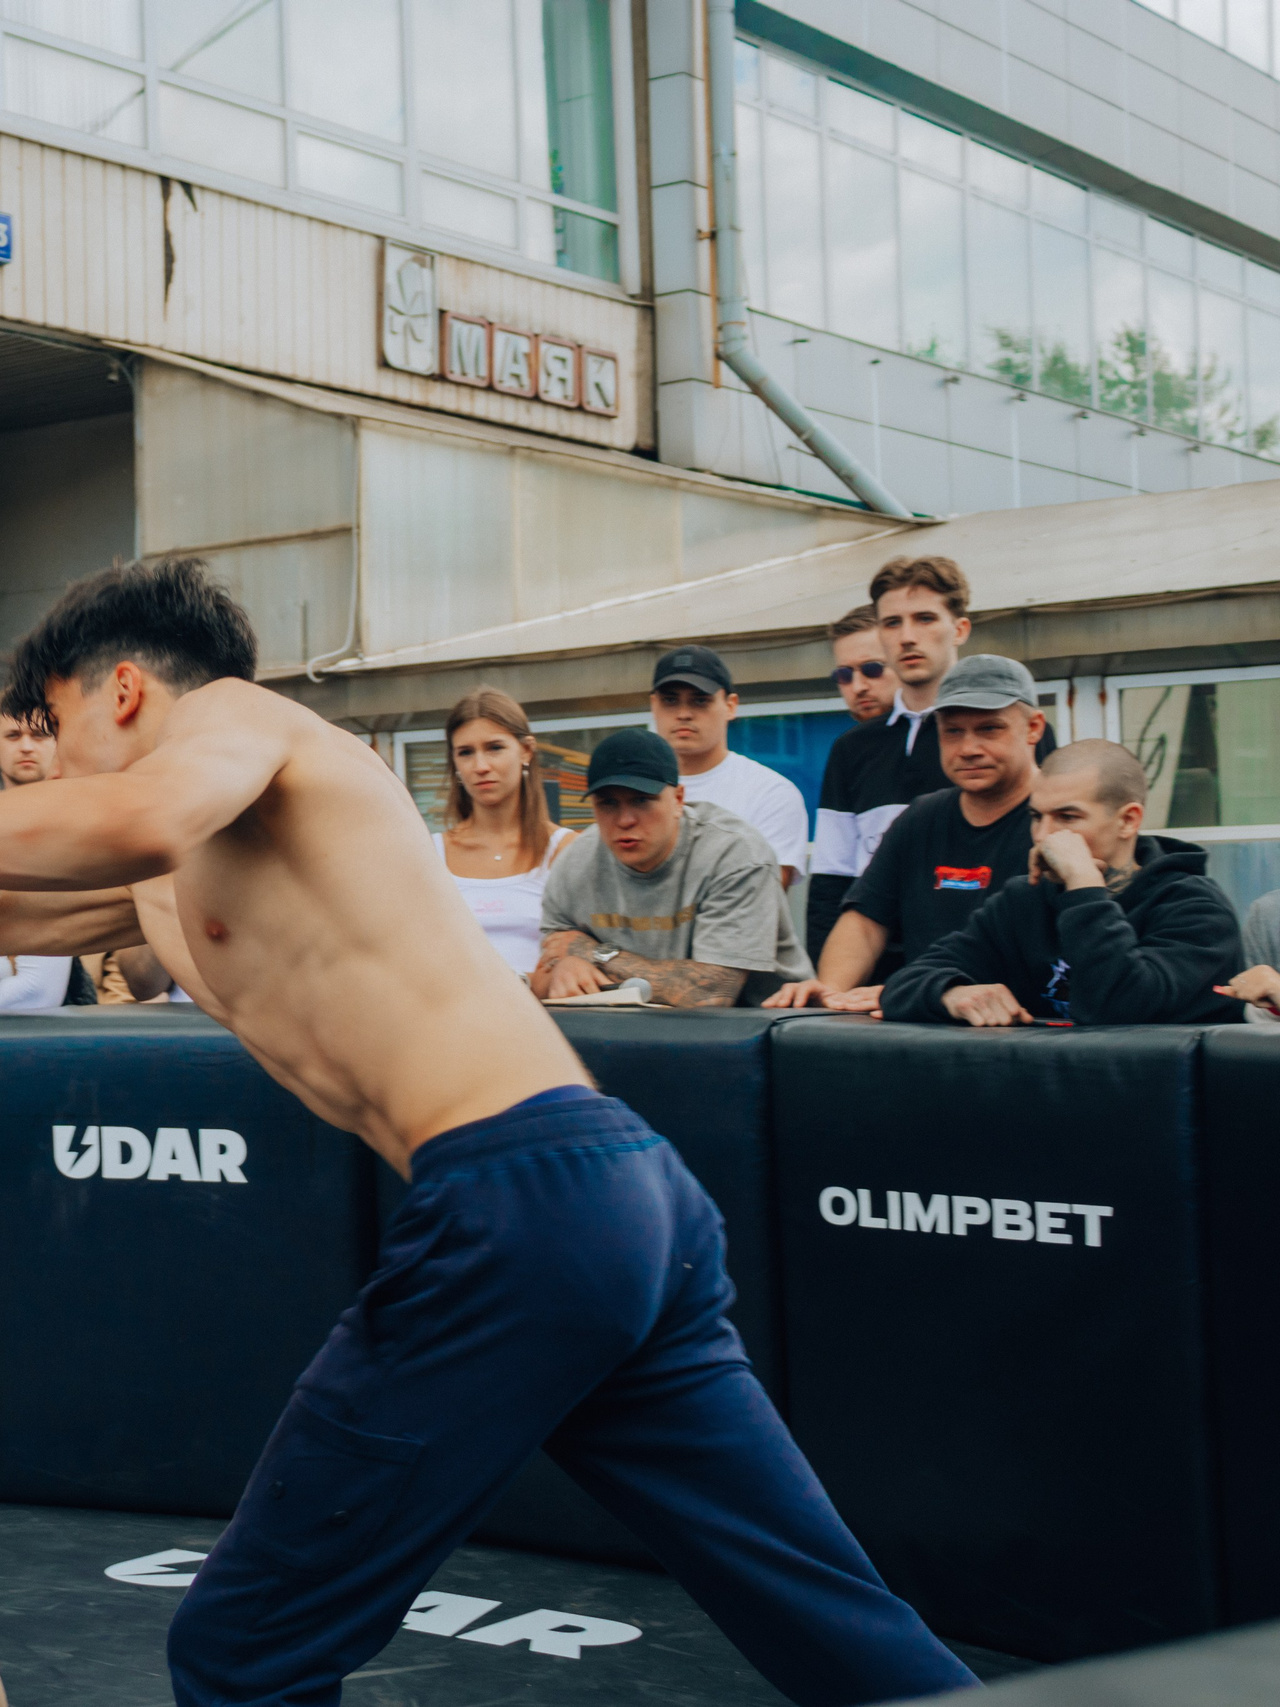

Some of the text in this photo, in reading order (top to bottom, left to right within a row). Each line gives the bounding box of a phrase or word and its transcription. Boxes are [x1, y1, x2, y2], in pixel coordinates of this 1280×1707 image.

[447, 318, 617, 410] МАЯК
[52, 1125, 248, 1183] UDAR
[819, 1186, 1114, 1247] OLIMPBET
